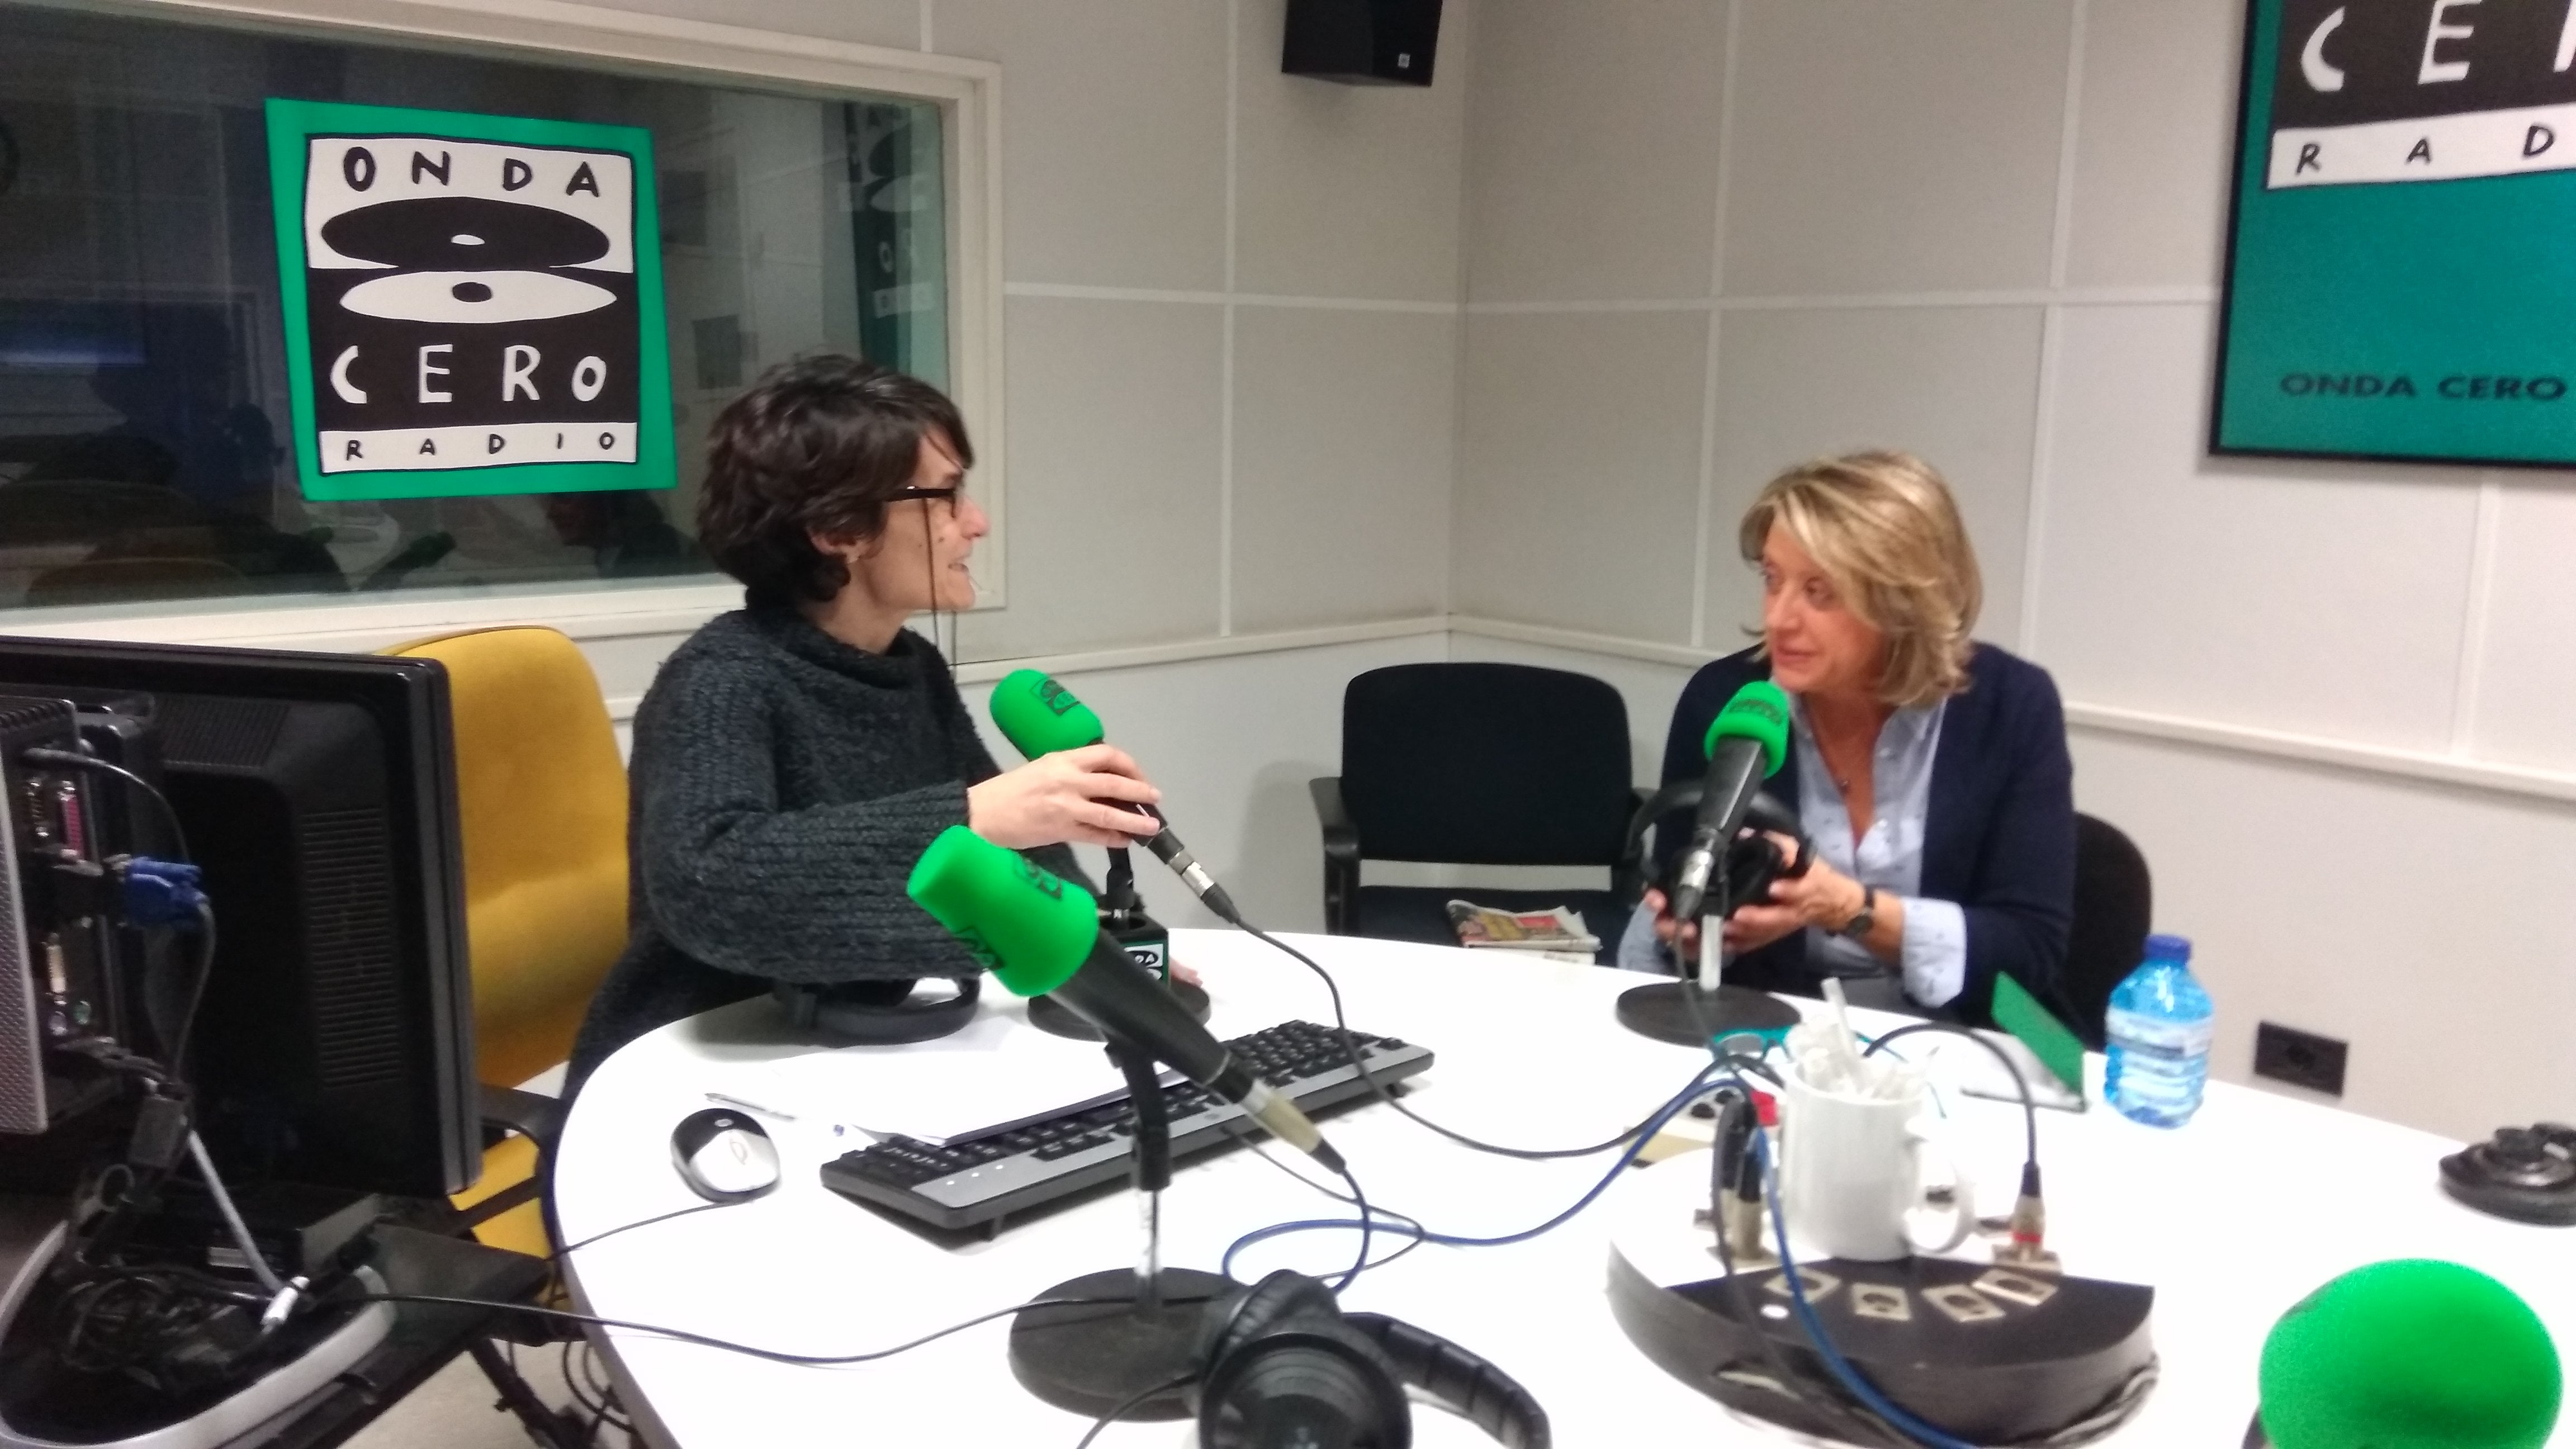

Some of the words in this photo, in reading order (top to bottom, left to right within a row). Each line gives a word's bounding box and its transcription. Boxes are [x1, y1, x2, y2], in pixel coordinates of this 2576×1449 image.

[343, 146, 600, 198] ONDA
[330, 343, 607, 404] CERO
[2280, 373, 2417, 397] ONDA
[2438, 375, 2568, 400] CERO
[346, 431, 615, 461] RADIO
